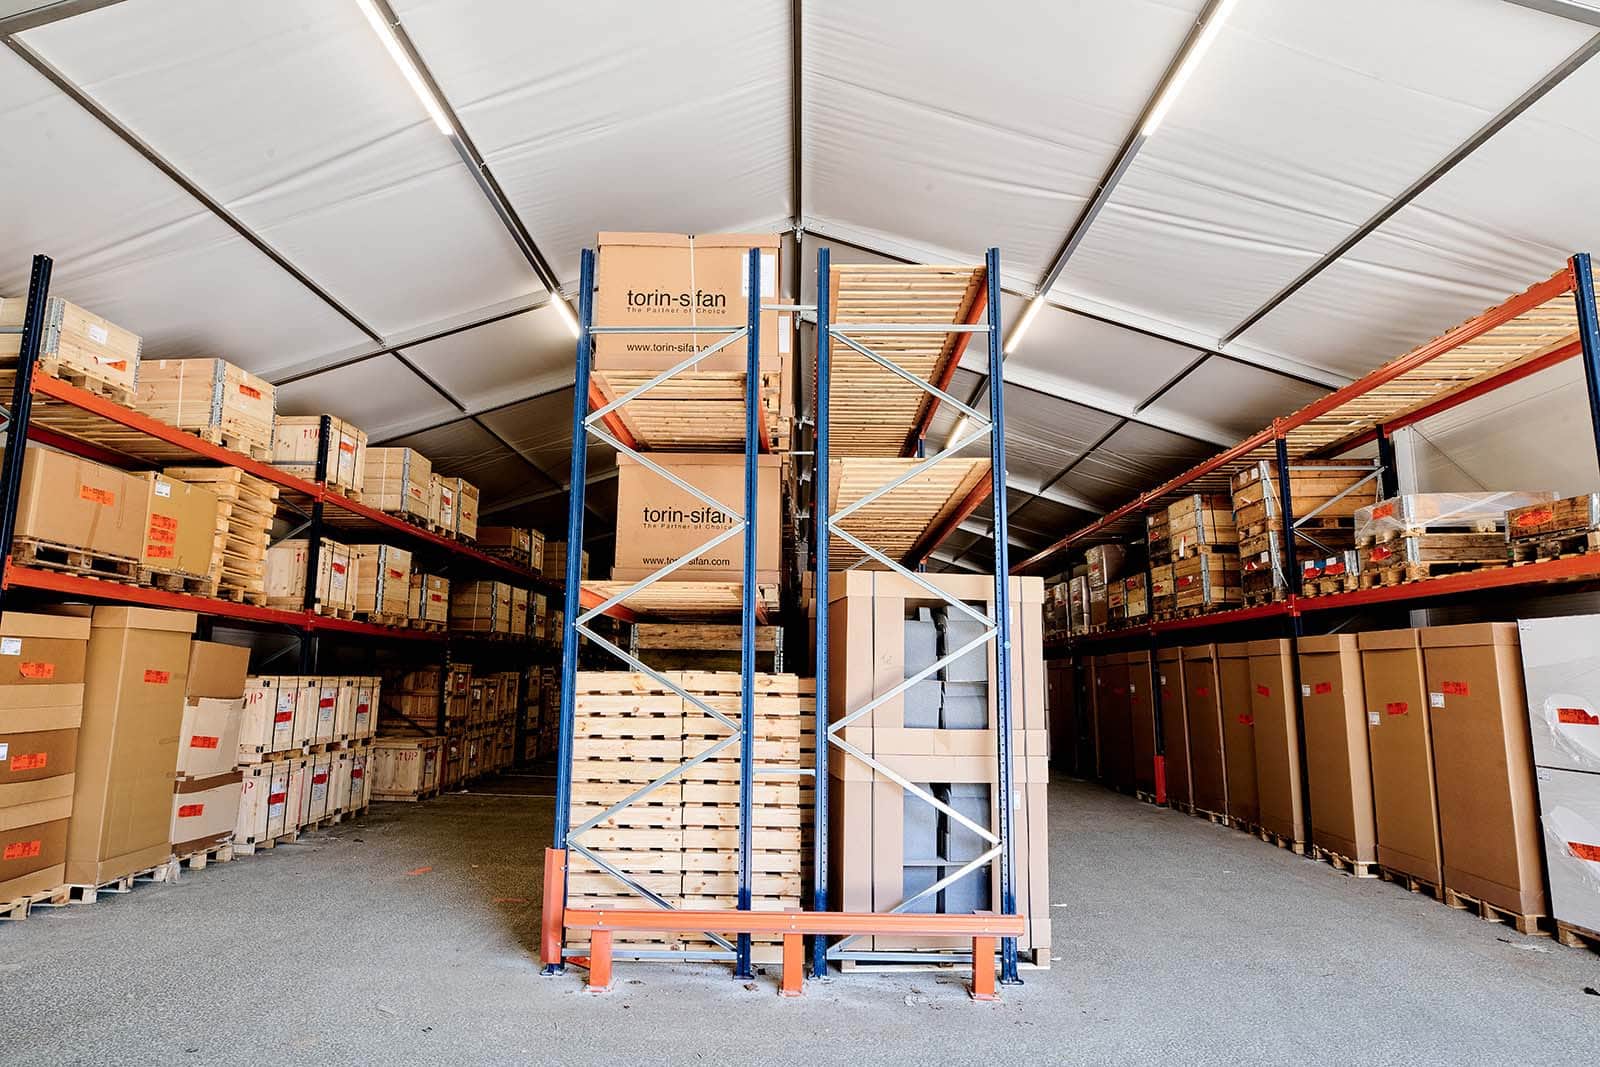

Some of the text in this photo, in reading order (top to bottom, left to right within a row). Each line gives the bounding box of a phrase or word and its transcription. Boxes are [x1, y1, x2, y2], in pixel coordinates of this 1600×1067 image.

[627, 289, 726, 307] torin-sfan
[696, 307, 727, 315] Choice
[626, 343, 724, 353] www.torin-sifan.c
